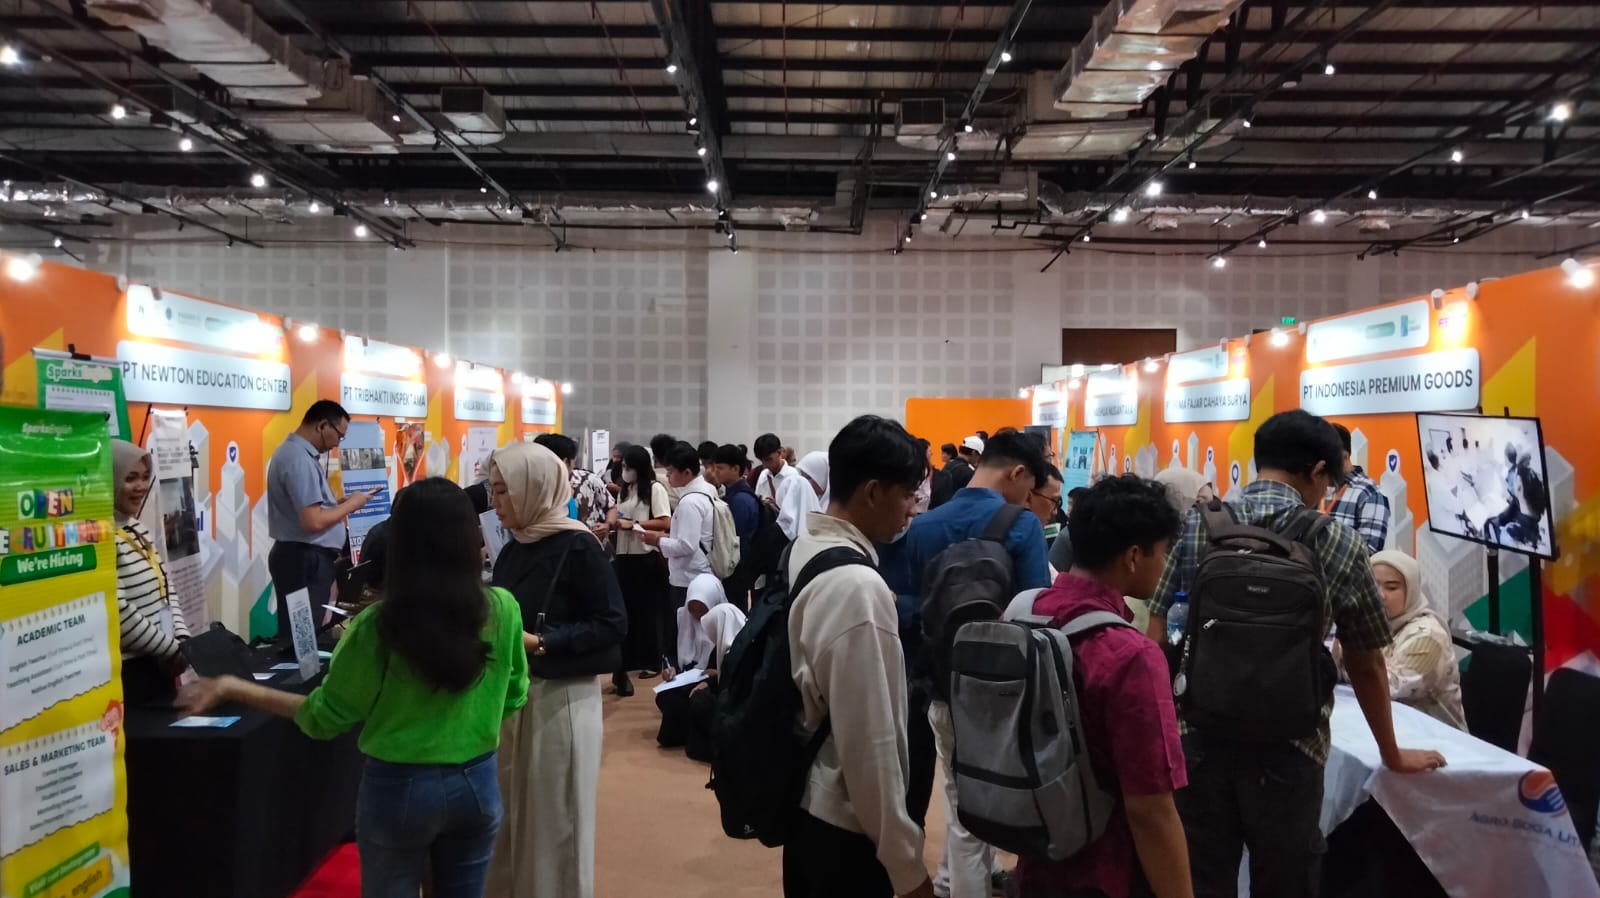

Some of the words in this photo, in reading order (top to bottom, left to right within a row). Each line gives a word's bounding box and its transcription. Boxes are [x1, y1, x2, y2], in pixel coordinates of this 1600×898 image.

[123, 361, 138, 379] PT
[142, 364, 194, 385] NEWTON
[196, 369, 254, 391] EDUCATION
[255, 377, 288, 394] CENTER
[1303, 385, 1313, 400] PT
[1315, 380, 1366, 398] INDONESIA
[1368, 374, 1421, 395] PREMIUM
[1424, 369, 1473, 390] GOODS
[1203, 394, 1226, 408] CAHAYA
[1227, 392, 1248, 407] SURYA
[18, 488, 74, 519] OPEN
[17, 556, 48, 574] We're
[49, 551, 84, 568] Hiring
[16, 622, 62, 647] ACADEMIC
[63, 613, 86, 630] TEAM
[4, 759, 30, 776] SALES
[32, 756, 39, 767] &
[40, 741, 86, 763] MARKETING
[87, 735, 107, 749] TEAM
